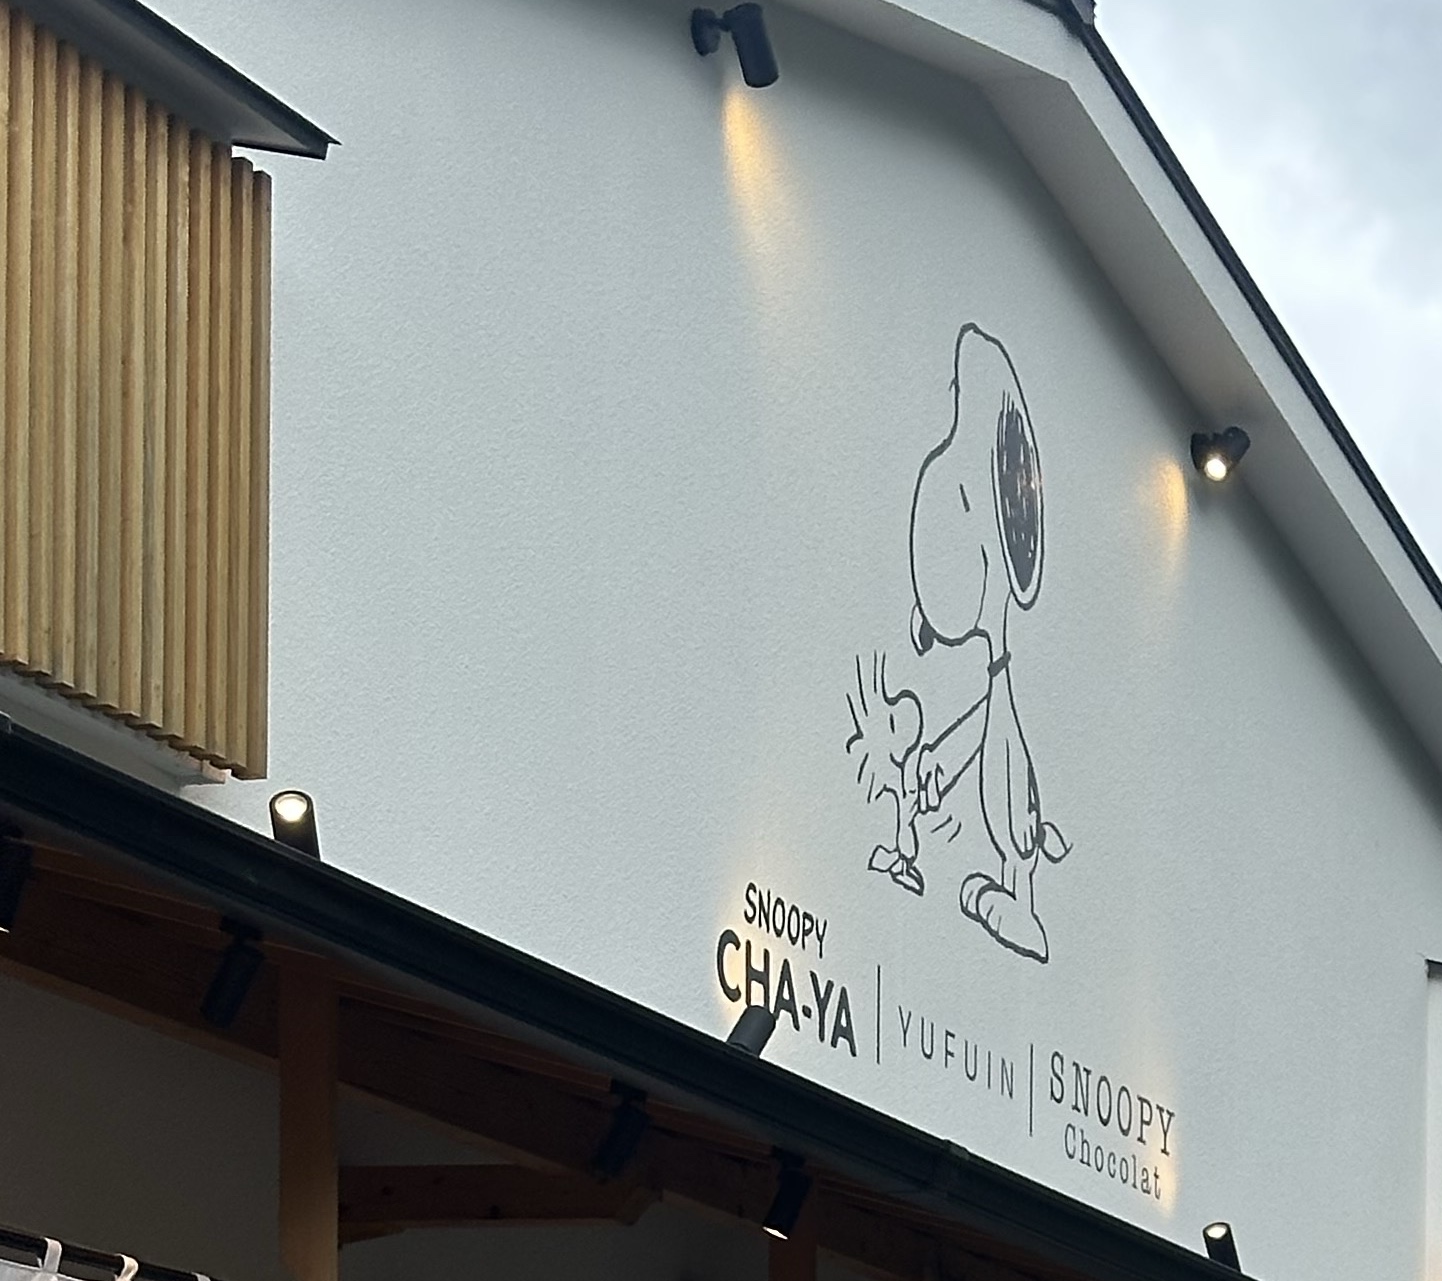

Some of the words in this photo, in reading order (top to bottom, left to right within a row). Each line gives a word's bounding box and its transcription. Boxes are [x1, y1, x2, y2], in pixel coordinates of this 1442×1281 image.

[743, 882, 828, 958] SNOOPY
[716, 929, 857, 1056] CHA-YA
[898, 1004, 1014, 1099] YUFUIN
[1048, 1051, 1175, 1157] SNOOPY
[1063, 1123, 1162, 1200] Chocolat
